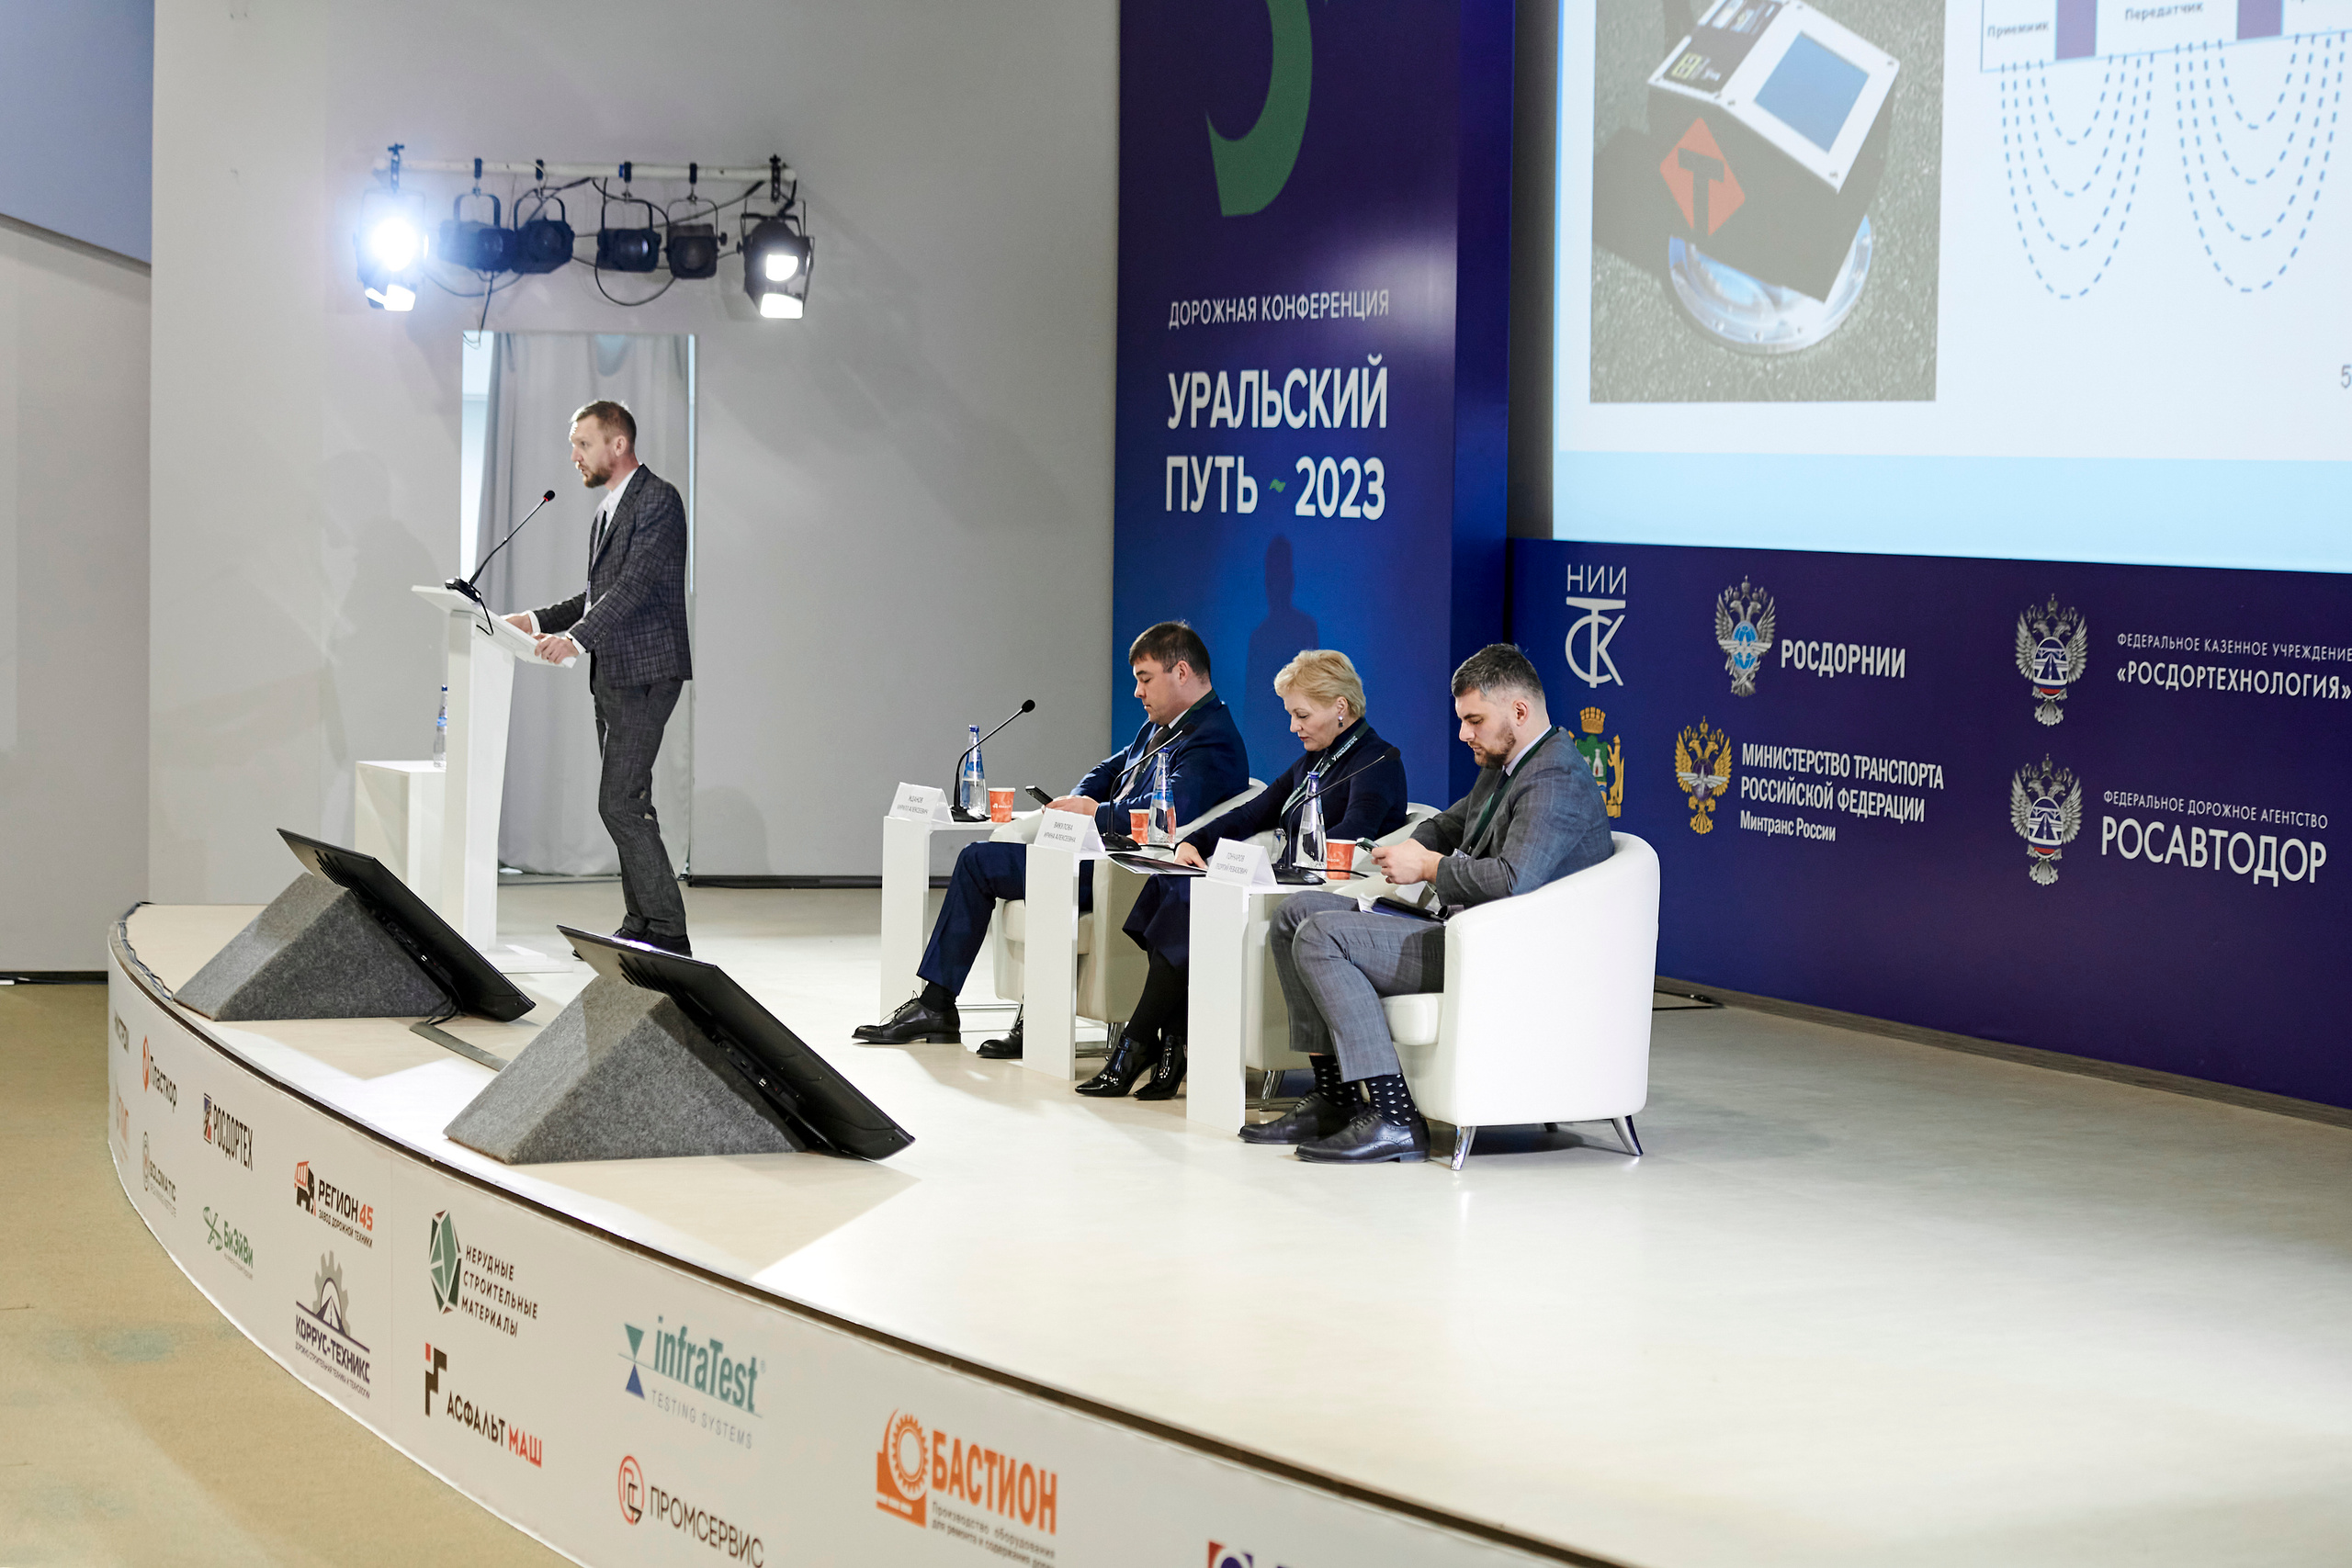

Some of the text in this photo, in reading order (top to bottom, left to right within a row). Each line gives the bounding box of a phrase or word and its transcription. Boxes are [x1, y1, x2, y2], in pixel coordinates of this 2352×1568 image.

[1987, 21, 2049, 39] Приемник
[2125, 2, 2204, 21] Передатчик
[1169, 289, 1389, 330] ДОРОЖНАЯ КОНФЕРЕНЦИЯ
[1168, 353, 1387, 429] УРАЛЬСКИЙ
[1166, 456, 1385, 520] ПУТЬ 2023
[1566, 564, 1627, 594] НИИ
[1781, 639, 1906, 678] РОСДОРНИИ
[2117, 633, 2352, 661] ФЕДЕРАЛЬНОЕ КАЗЕННОЕ УЧРЕЖДЕНИЕ
[2117, 660, 2352, 699] «РОСДОРТЕХНОЛОГИЯ»
[1742, 742, 1944, 790] МИНИСТЕРСТВО ТРАНСПОРТА
[1741, 776, 1925, 822] РОССИЙСКОЙ ФЕДЕРАЦИИ
[2103, 790, 2328, 829] ФЕДЕРАЛЬНОЕ ДОРОЖНОЕ АГЕНТСТВО
[1740, 810, 1836, 841] Минтранс России
[2101, 816, 2327, 887] РОСАВТОДОР
[150, 1055, 177, 1113] Пласткор
[213, 1104, 254, 1171] РОСДОРТЕХ
[318, 1179, 373, 1232] РЕГИОН 45
[223, 1220, 254, 1269] БиЭйВи
[466, 1245, 514, 1281] НЕРУДНЫЕ
[461, 1295, 518, 1337] МАТЕРИАЛЫ
[463, 1270, 538, 1320] СТРОИТЕЛЬНЫЕ
[295, 1314, 370, 1384] КОРРУС-ТЕХНИКС
[653, 1314, 758, 1413] infraTest
[447, 1390, 542, 1469] АСФАЛЬТ МАШ
[651, 1389, 752, 1450] TESTING SYSTEMS
[932, 1429, 1057, 1536] БАСТИОН
[650, 1485, 764, 1568] ПРОМСЕРВИС
